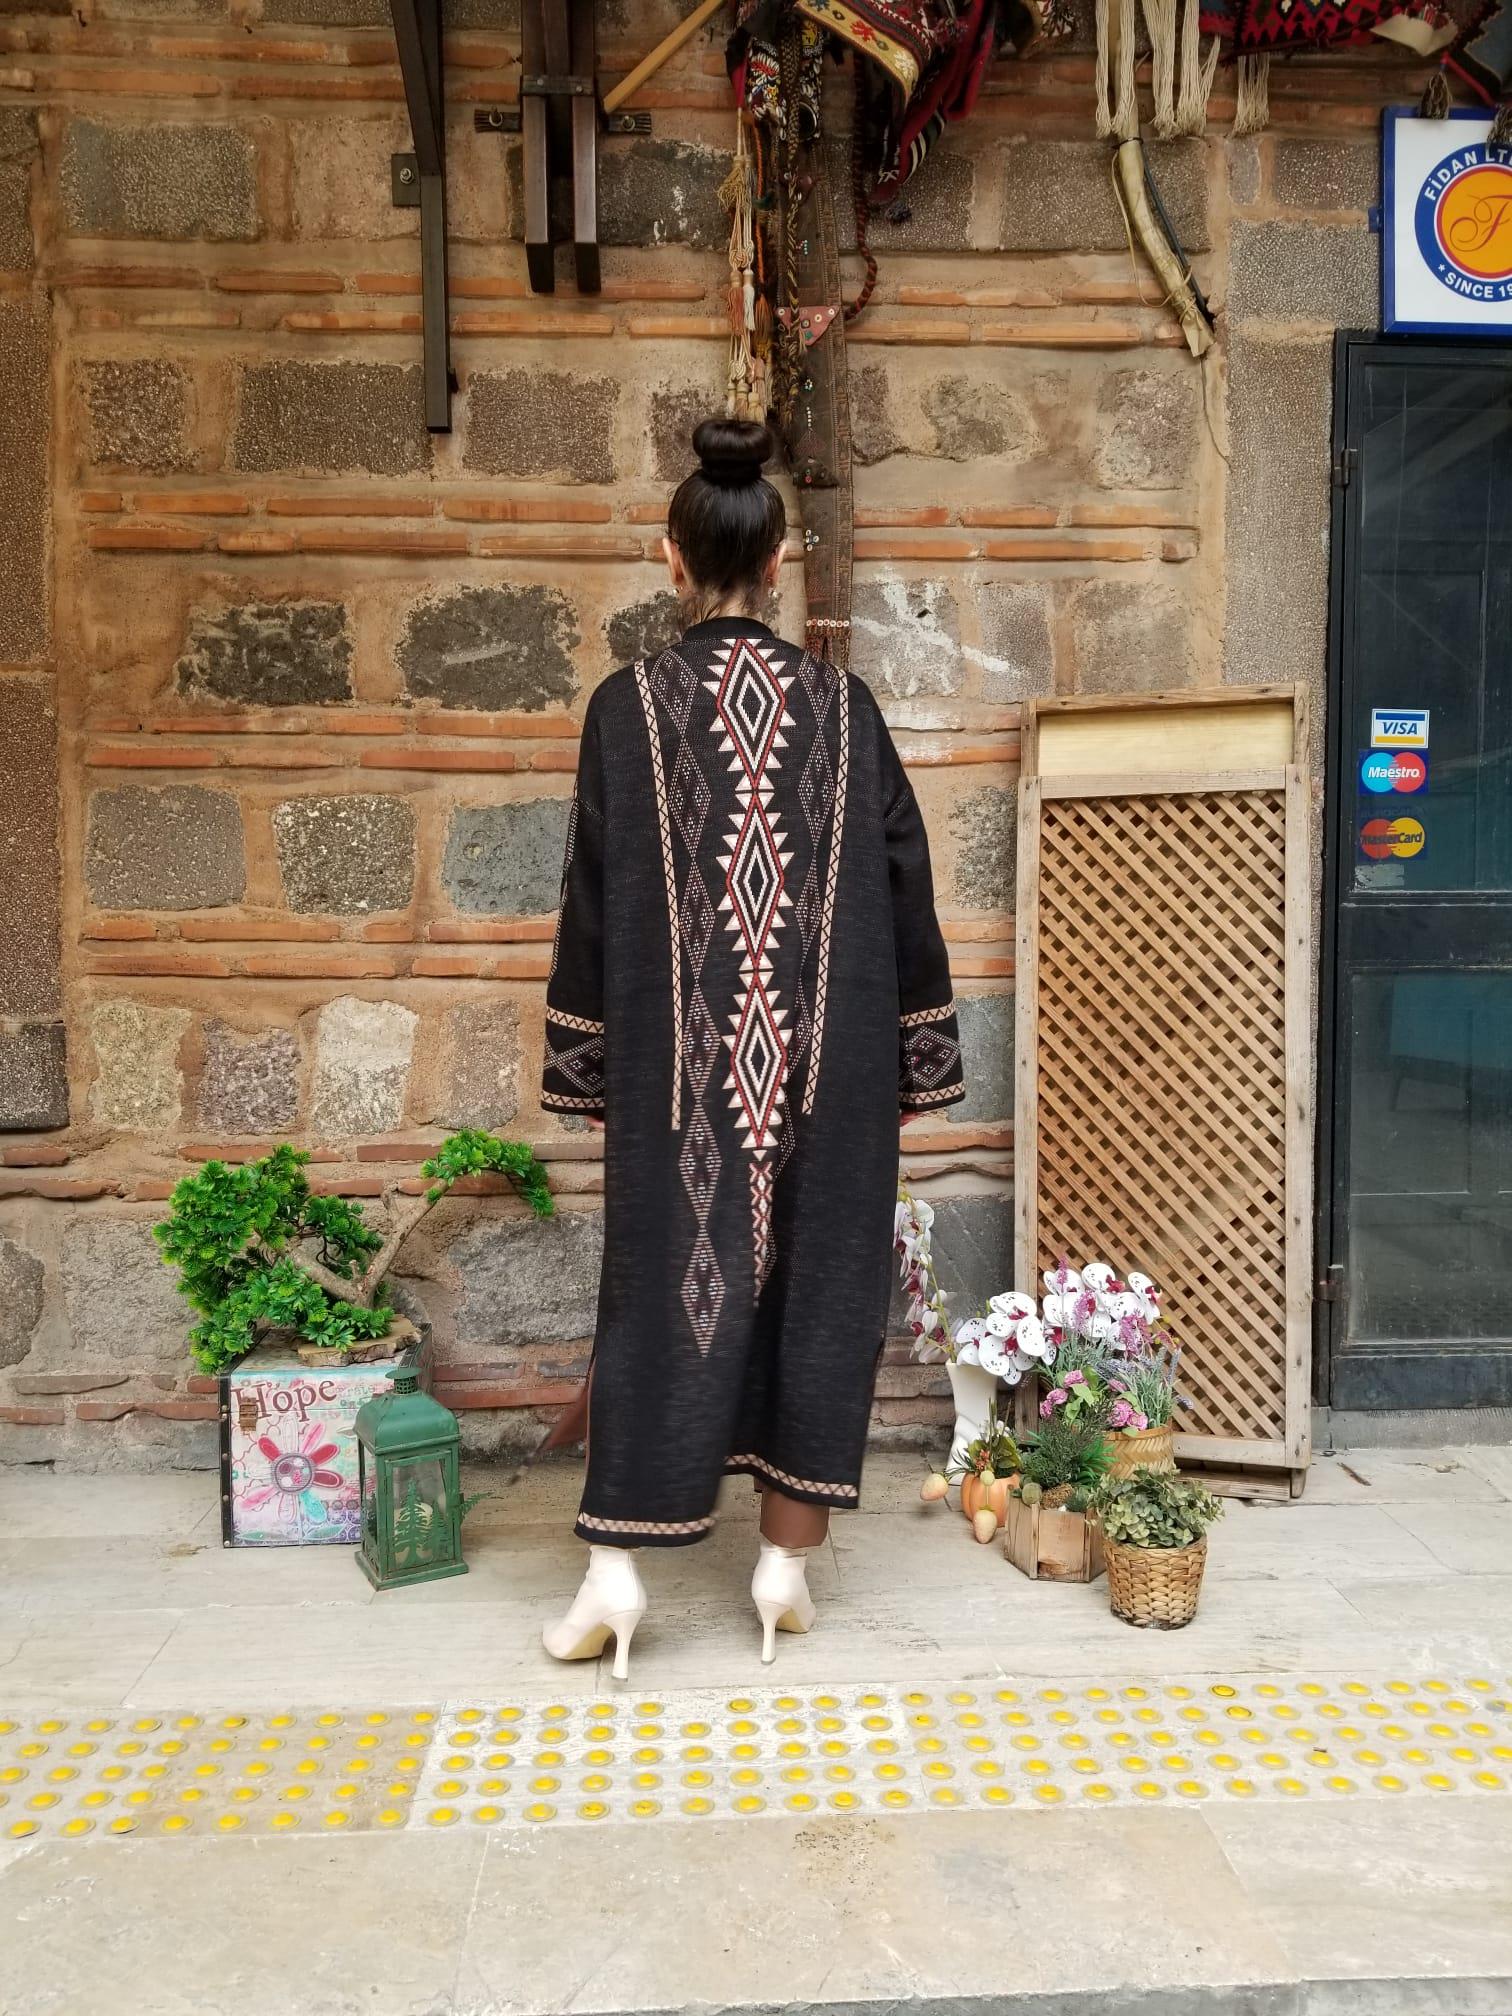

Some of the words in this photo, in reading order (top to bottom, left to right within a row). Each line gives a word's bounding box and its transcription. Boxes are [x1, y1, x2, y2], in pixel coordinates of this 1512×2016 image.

[1485, 147, 1512, 166] LT
[1445, 272, 1494, 298] SINCE
[1382, 721, 1418, 735] VISA
[1368, 766, 1420, 778] Maestro
[231, 1380, 337, 1423] Hope
